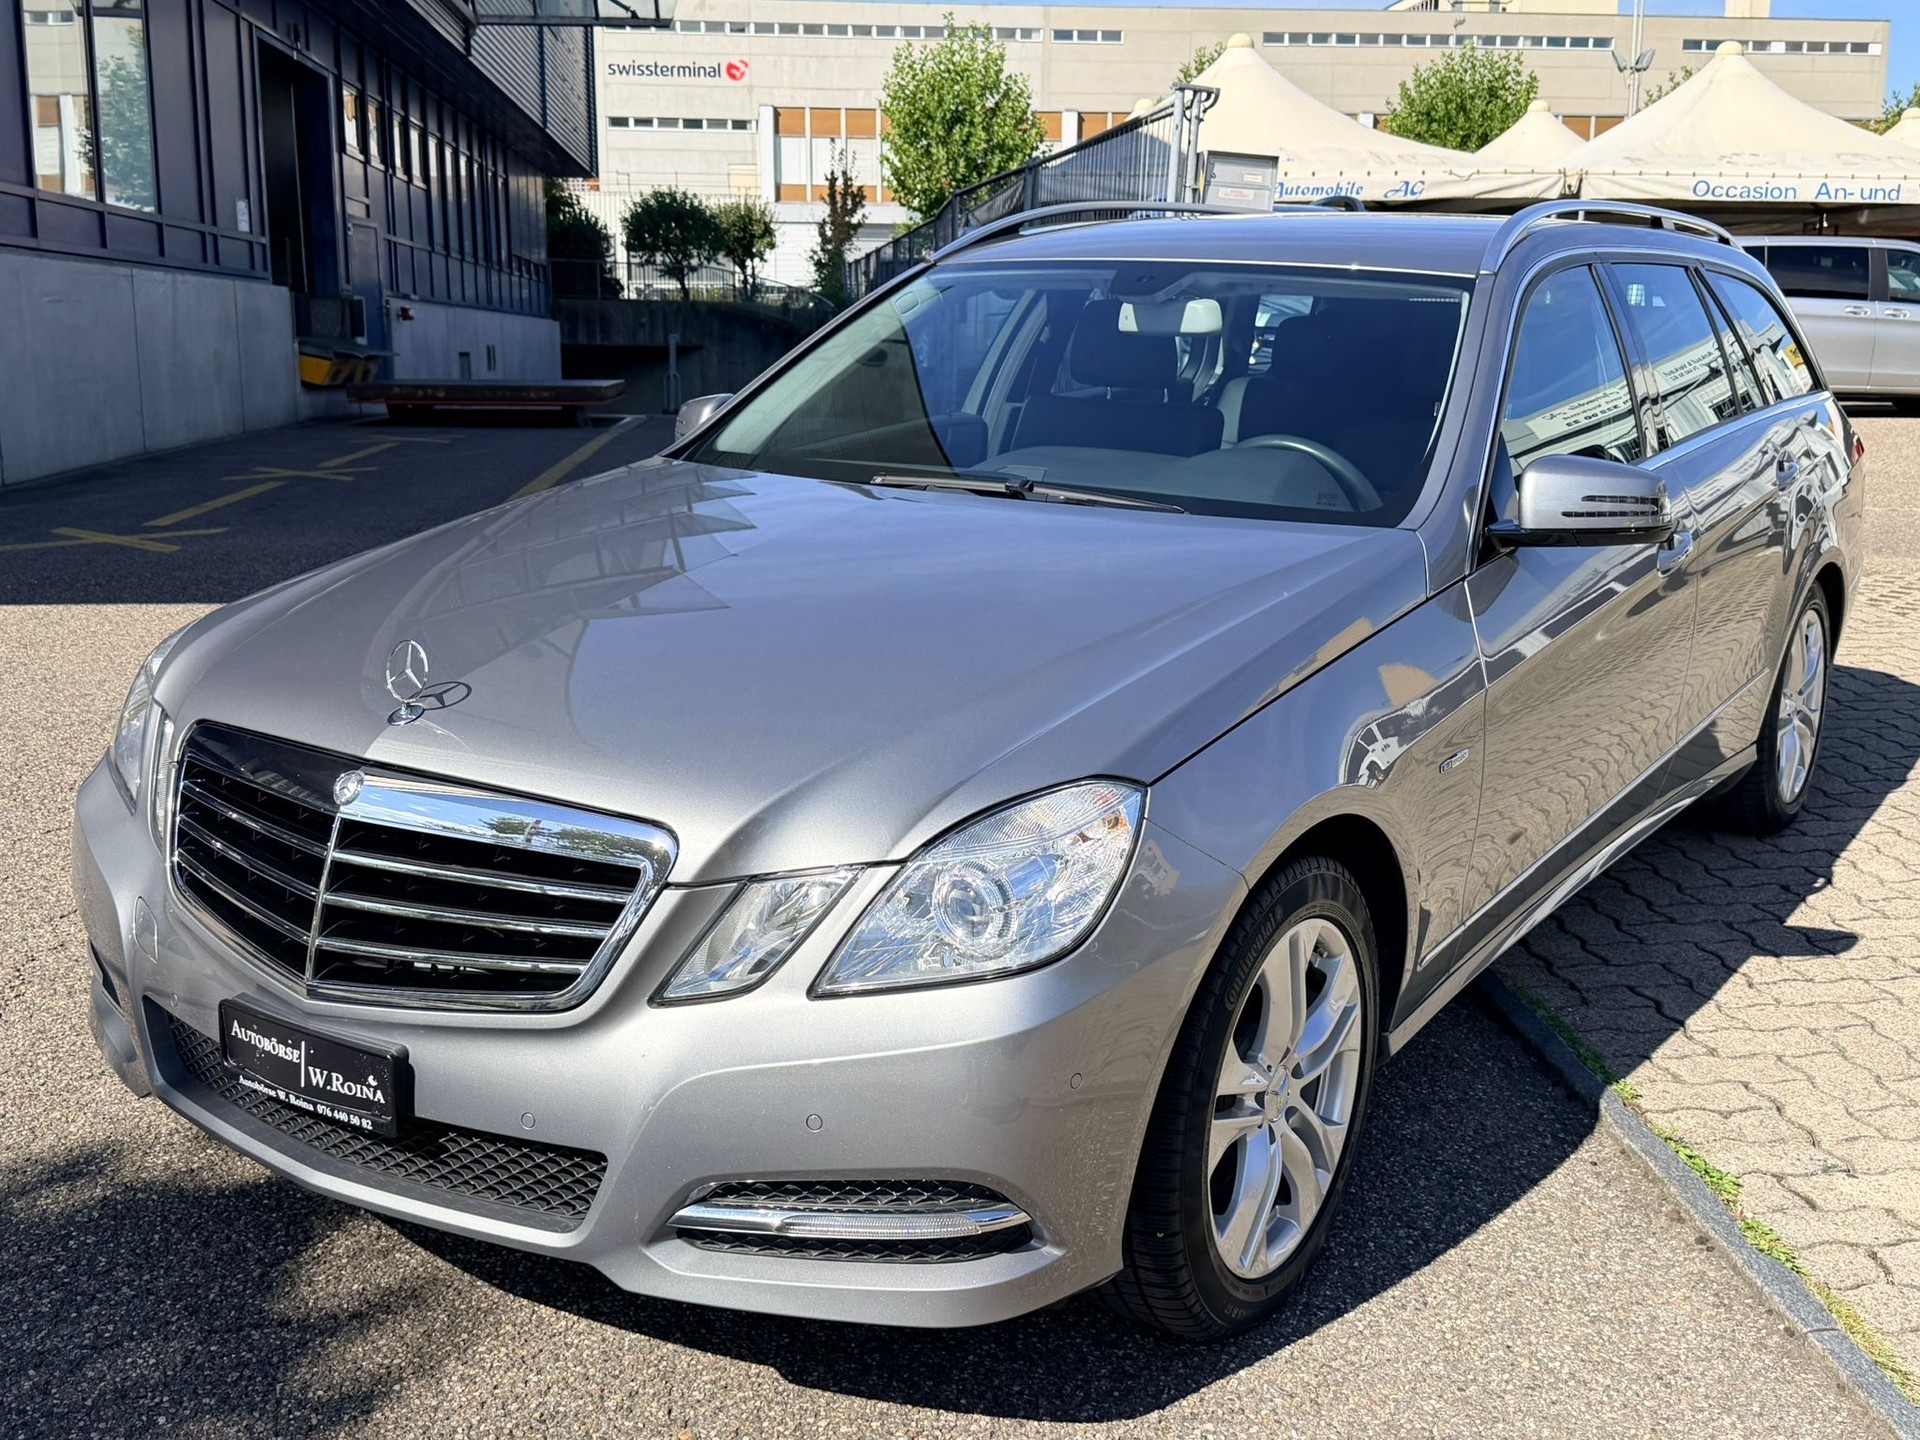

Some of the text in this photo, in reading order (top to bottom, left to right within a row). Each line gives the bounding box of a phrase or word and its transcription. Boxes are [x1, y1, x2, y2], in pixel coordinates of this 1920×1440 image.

[607, 60, 721, 78] swissterminal
[1275, 180, 1425, 199] Automobile AG
[1692, 180, 1902, 201] Occasion An- und
[289, 1094, 314, 1111] Roina
[316, 1103, 332, 1117] 076
[333, 1109, 348, 1122] 440
[349, 1114, 360, 1126] 50
[361, 1118, 373, 1130] 82
